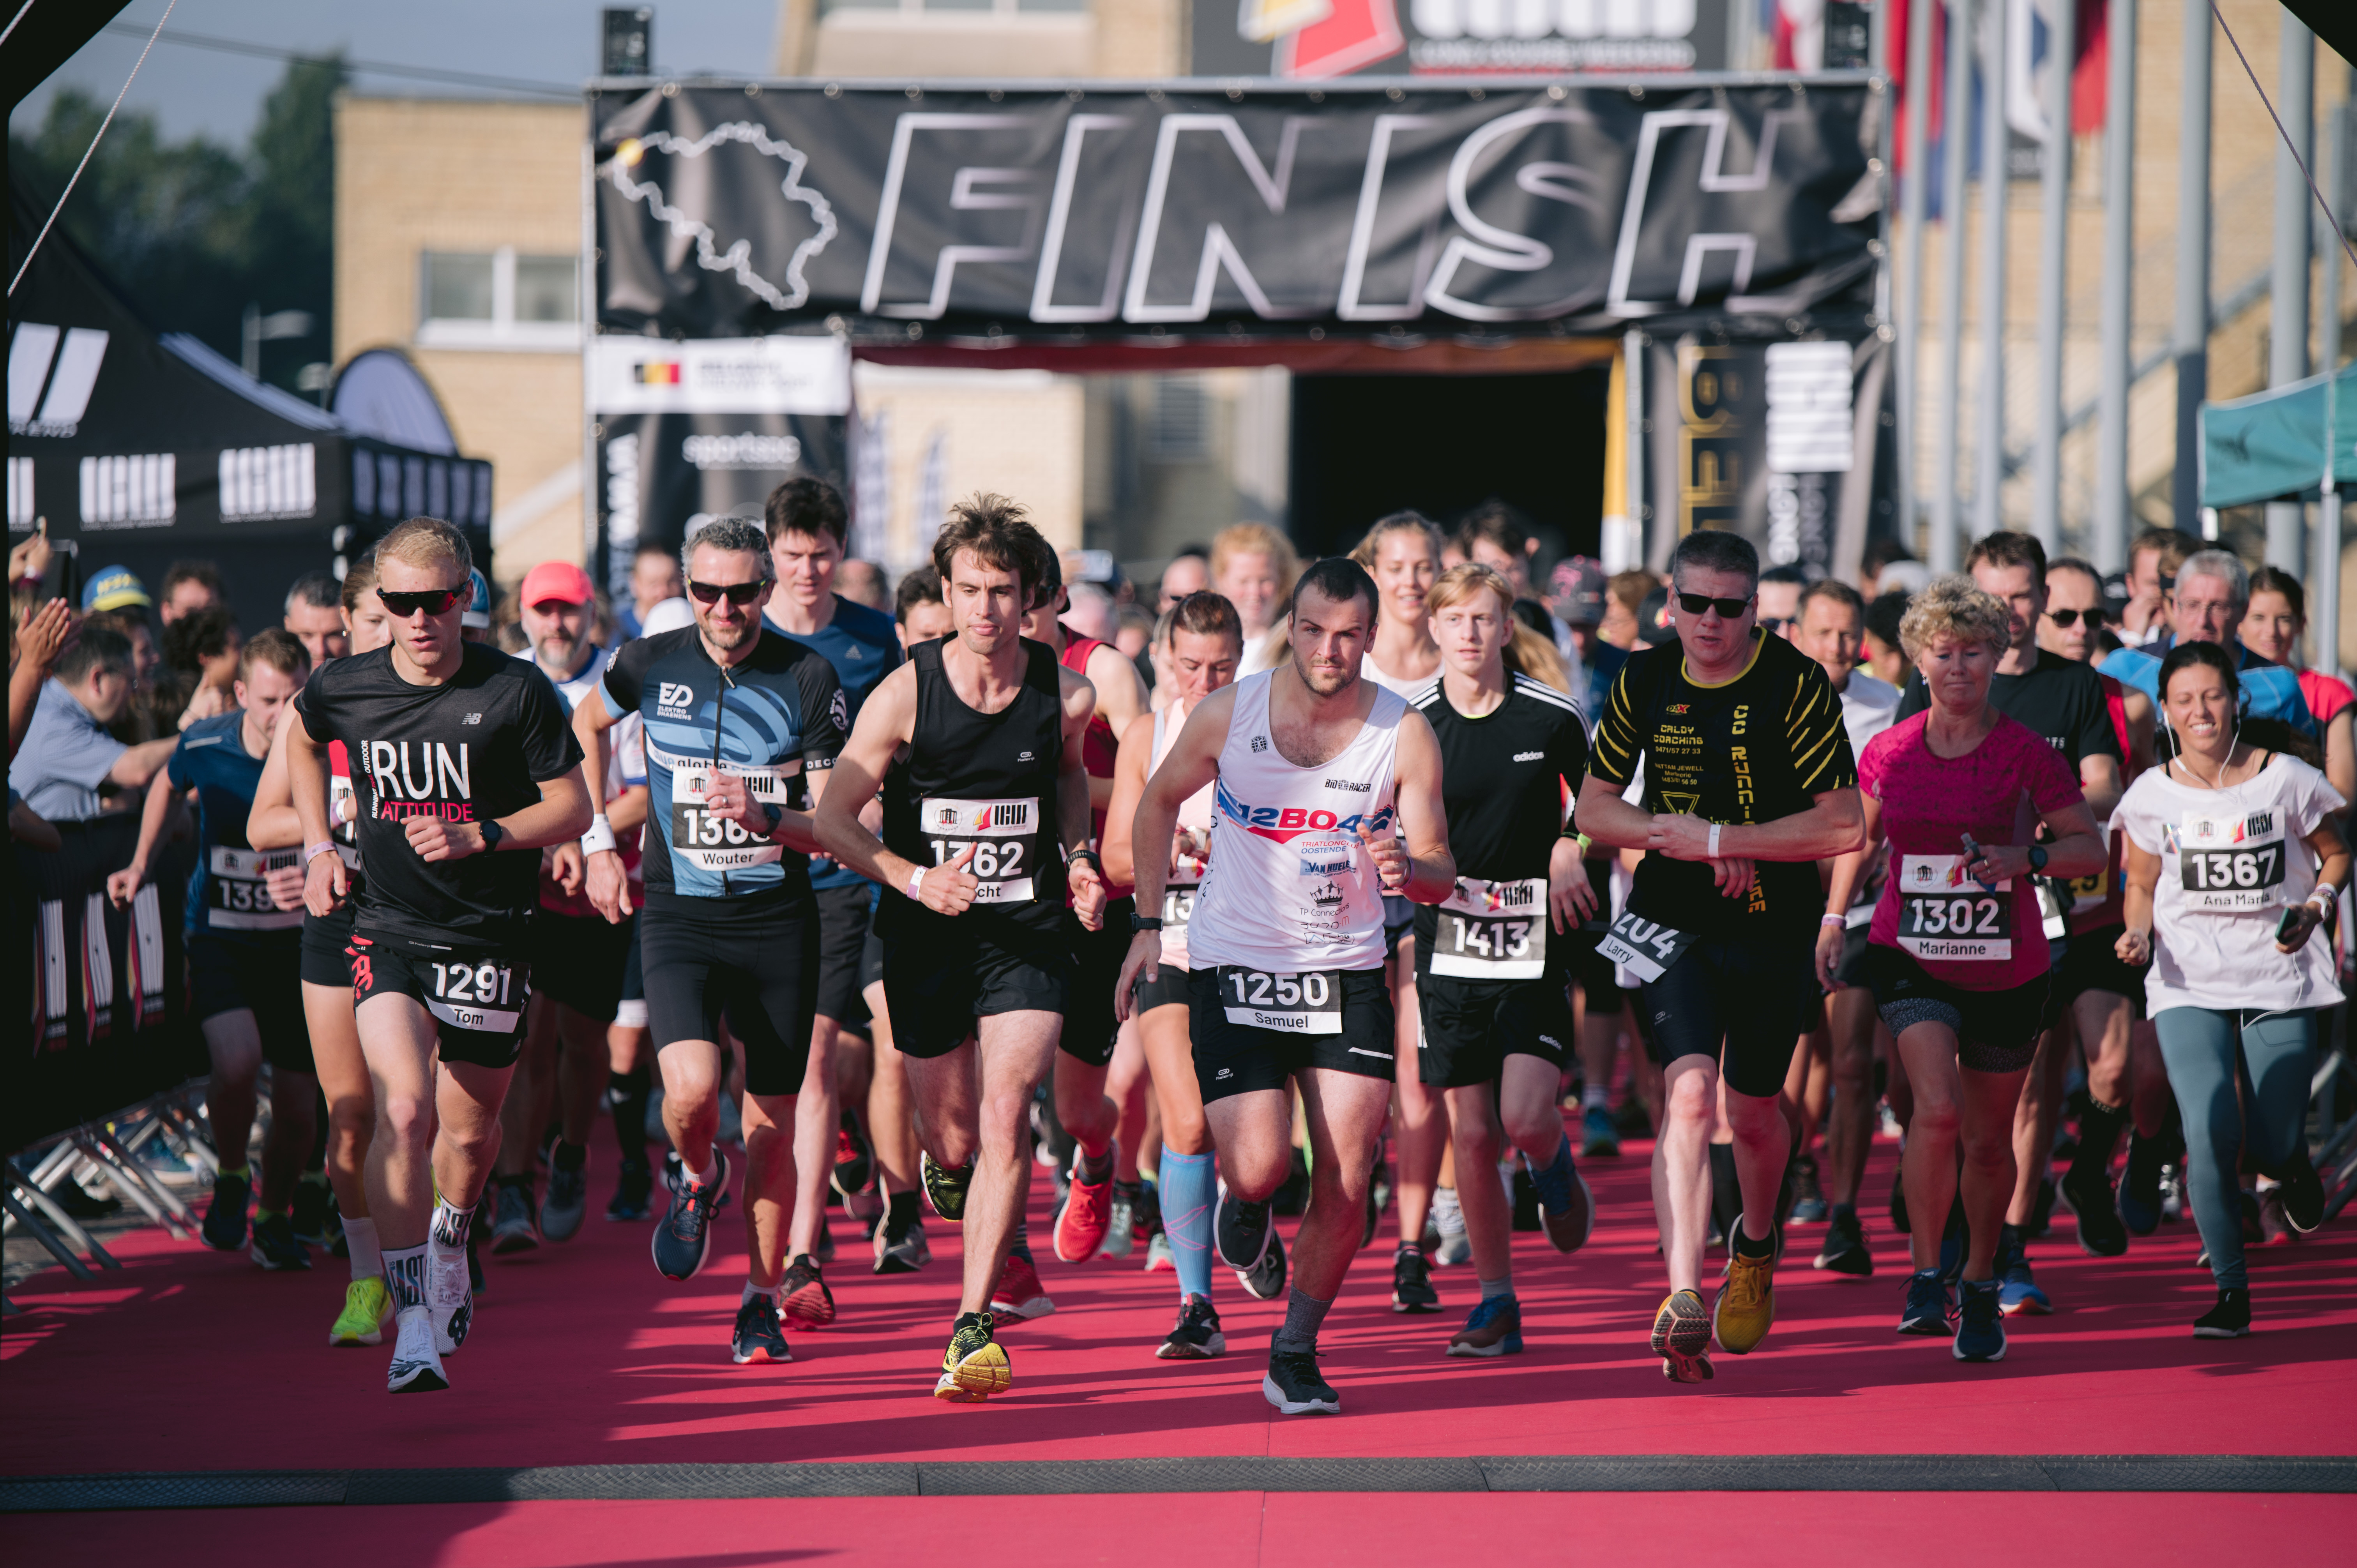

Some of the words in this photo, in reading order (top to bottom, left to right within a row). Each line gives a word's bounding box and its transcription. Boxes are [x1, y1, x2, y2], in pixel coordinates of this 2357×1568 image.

[860, 107, 1805, 323] FINISH
[656, 710, 692, 721] DHAENENS
[657, 705, 687, 714] ELEKTRO
[1661, 724, 1694, 735] CALDY
[361, 740, 371, 774] OUTDOOR
[1513, 750, 1544, 763] adidas
[371, 740, 470, 800] RUN
[1348, 782, 1371, 793] RACER
[380, 801, 474, 822] ATTITUDE
[683, 809, 770, 846] 136
[1301, 846, 1347, 854] OOSTENDE
[703, 853, 754, 864] Wouter
[930, 840, 1024, 878] 1362
[1308, 862, 1326, 873] VAN
[2192, 847, 2277, 888] 1367
[2204, 894, 2231, 906] Ana
[1311, 902, 1350, 916] Connections
[1911, 898, 2000, 934] 1302
[1452, 917, 1529, 958] 1413
[1606, 939, 1634, 964] Larry
[1919, 941, 1986, 955] Marianne
[432, 962, 511, 1005] 1291
[1228, 972, 1329, 1007] 1250
[454, 1009, 484, 1025] Tom
[1255, 1012, 1309, 1028] Samuel
[1216, 1072, 1234, 1081] Kalenji
